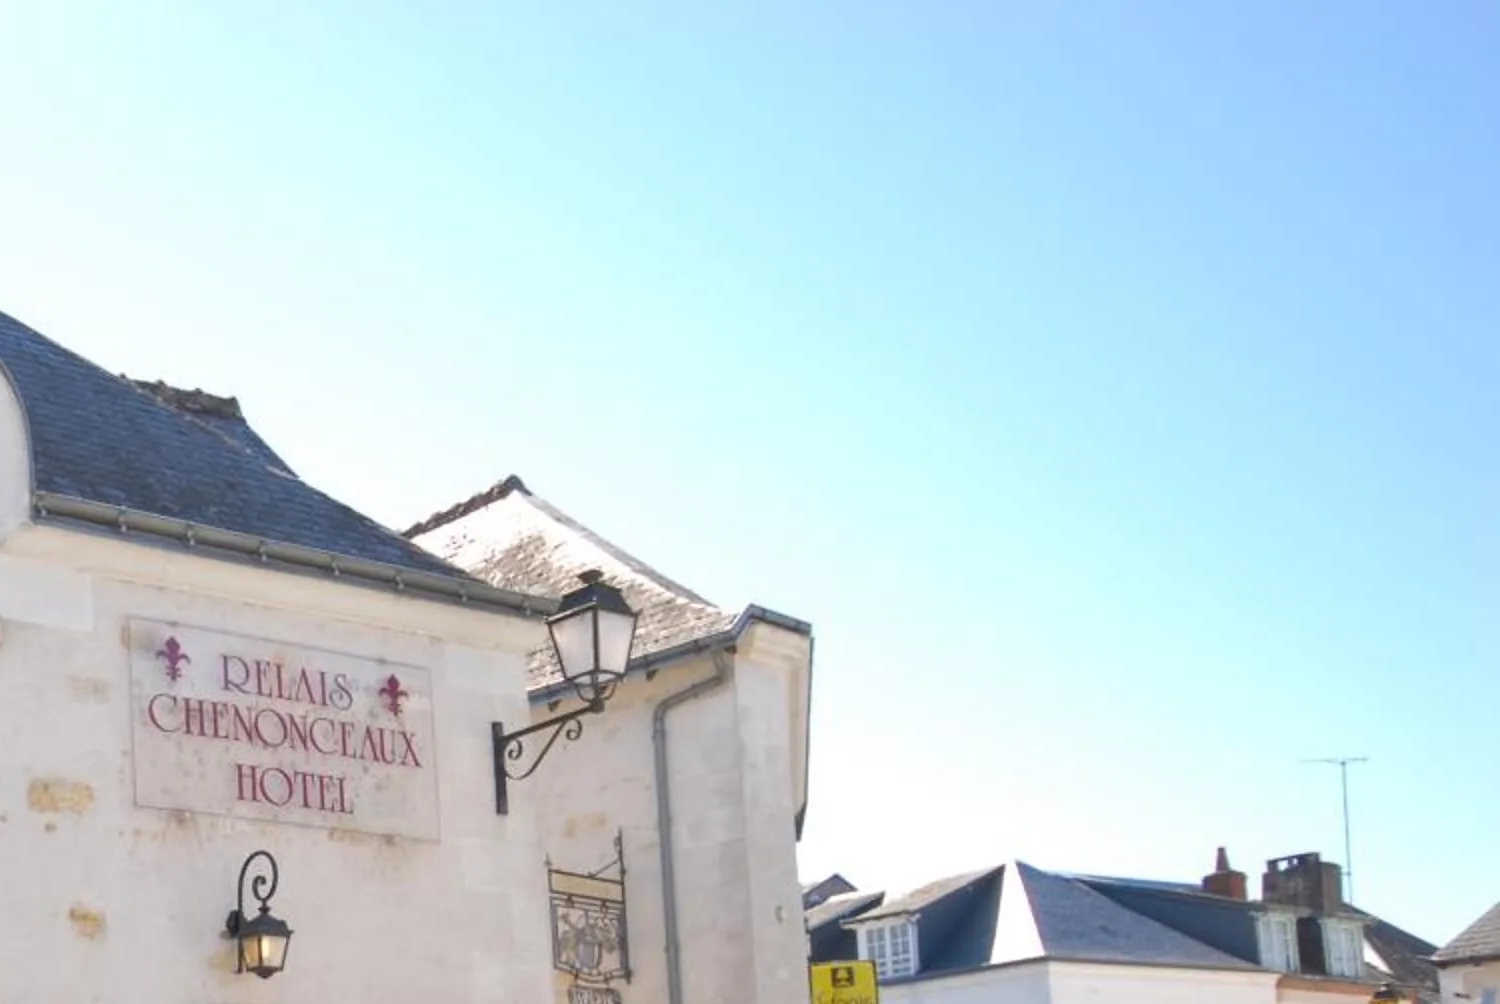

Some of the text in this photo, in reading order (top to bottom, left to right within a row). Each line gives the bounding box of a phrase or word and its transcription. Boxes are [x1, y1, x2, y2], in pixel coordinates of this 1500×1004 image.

[220, 653, 354, 711] RELAIS
[148, 692, 422, 768] CHENONCEAUX
[235, 763, 355, 815] HOTEL
